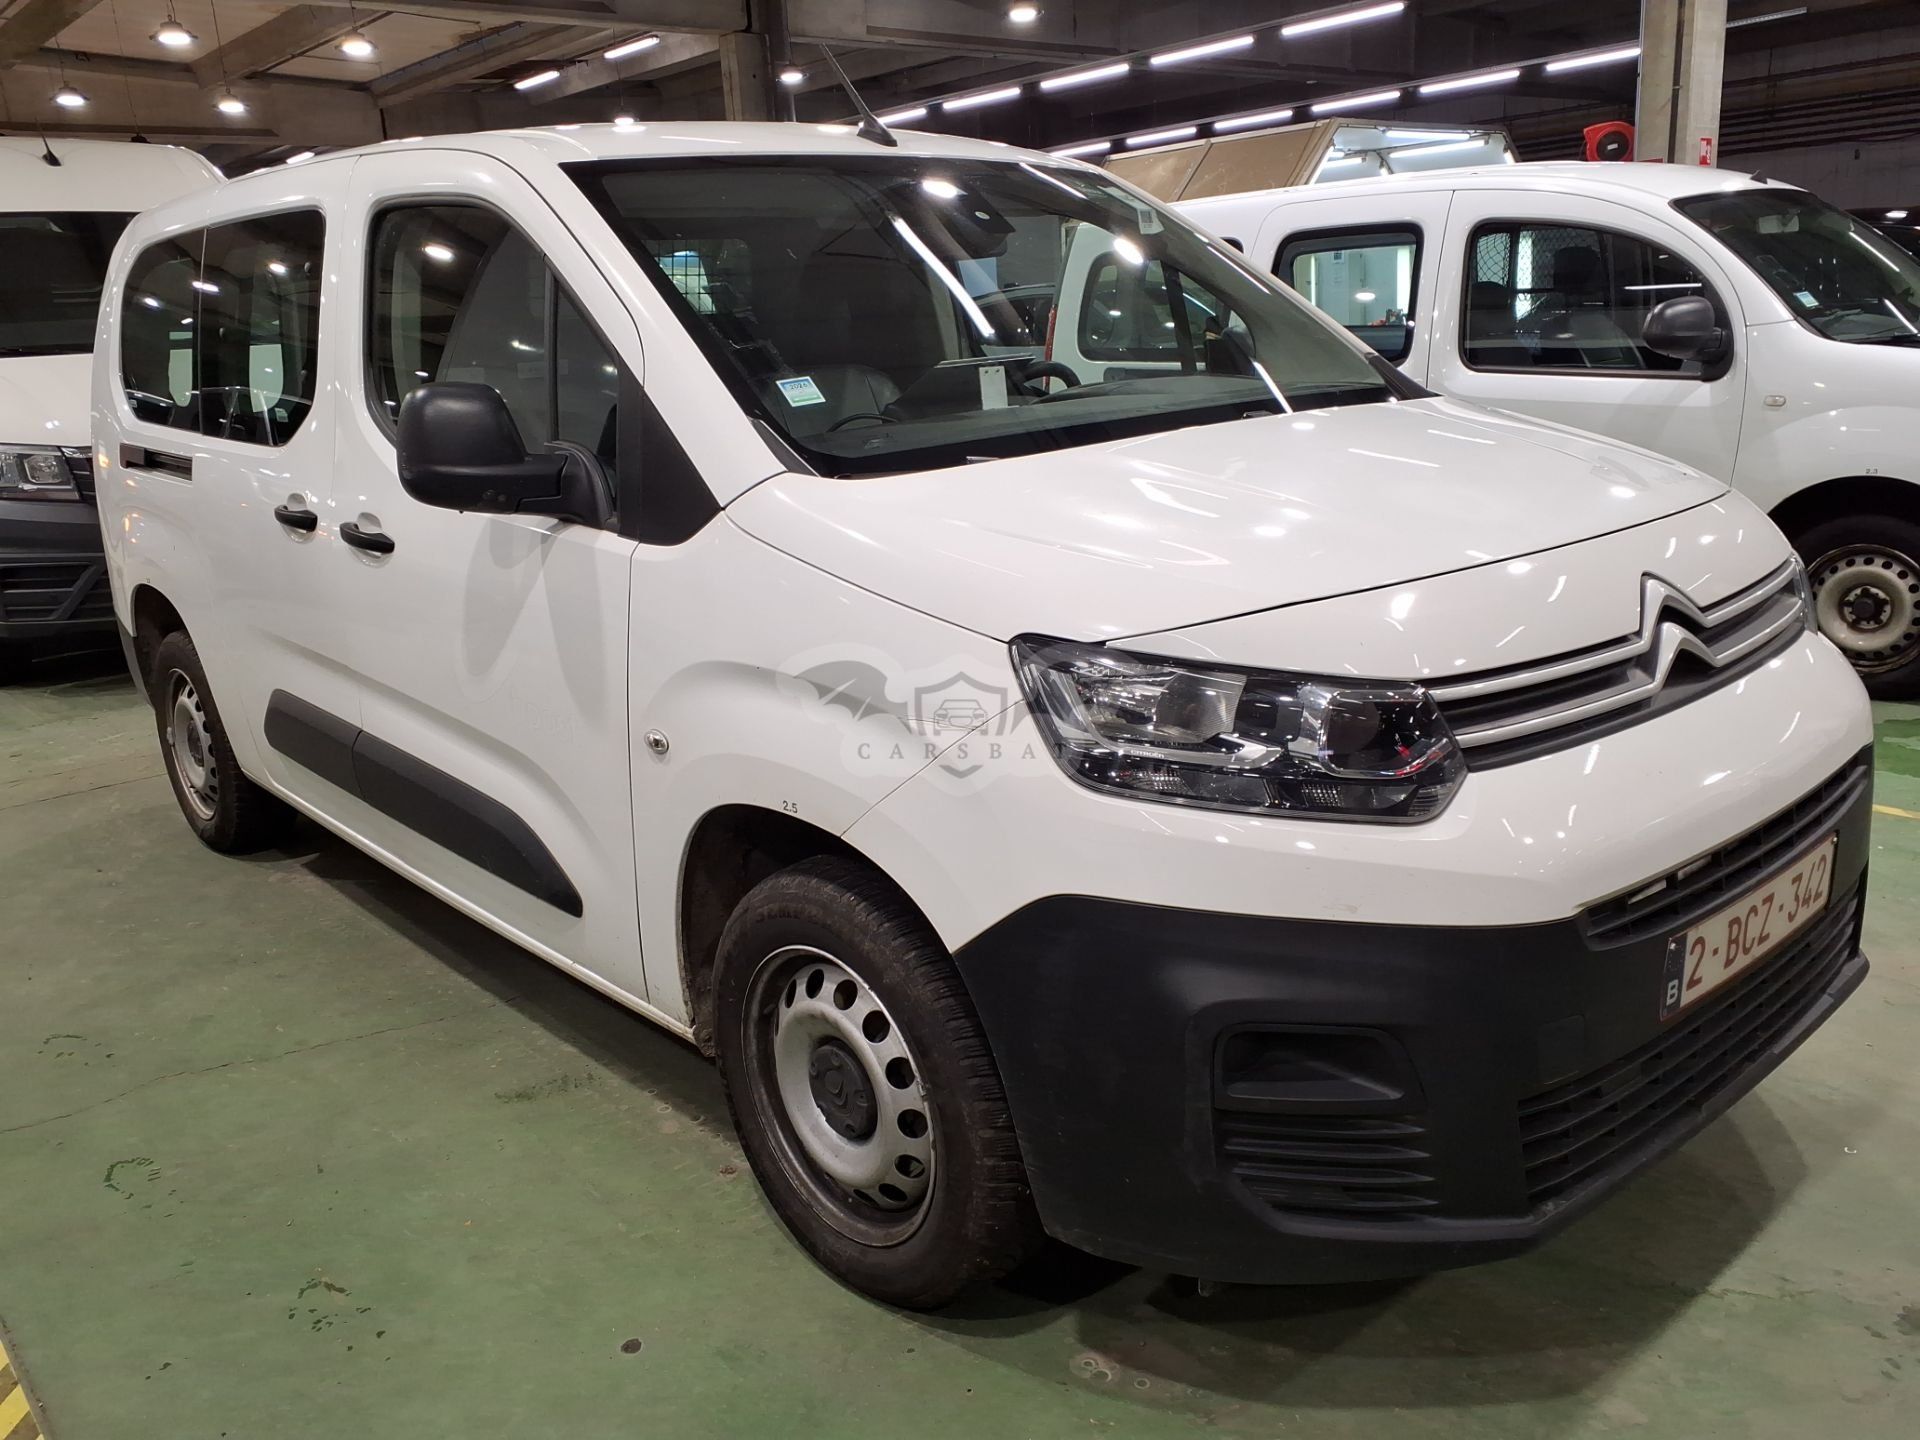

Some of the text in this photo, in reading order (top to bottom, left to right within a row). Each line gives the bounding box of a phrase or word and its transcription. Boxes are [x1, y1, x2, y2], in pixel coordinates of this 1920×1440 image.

[783, 800, 798, 813] 2.5
[1686, 854, 1828, 992] 2-BCZ-342
[1666, 978, 1679, 1006] B
